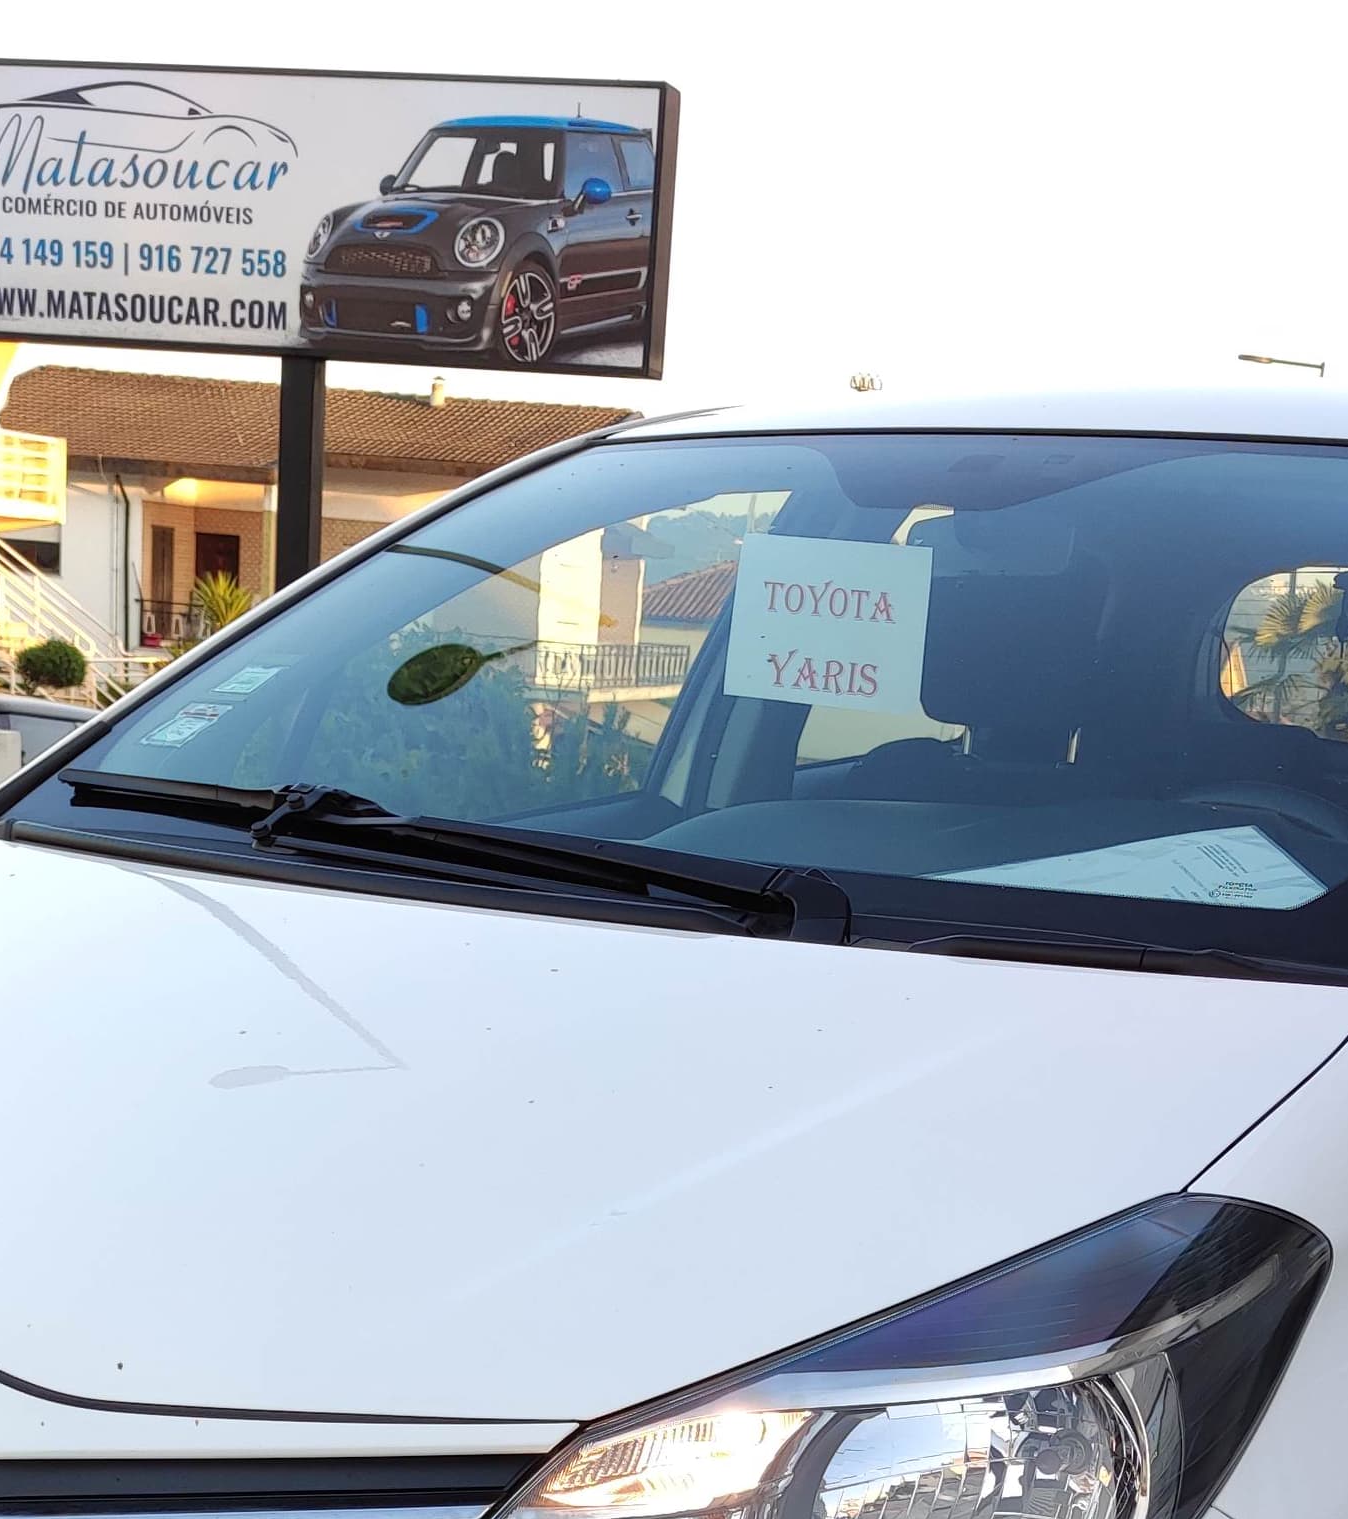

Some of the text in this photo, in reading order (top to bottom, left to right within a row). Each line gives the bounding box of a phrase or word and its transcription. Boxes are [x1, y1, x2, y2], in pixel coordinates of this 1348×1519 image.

[1, 193, 254, 225] COMÉRCIO DE AUTOMÓVEIS
[21, 238, 64, 267] 149
[72, 240, 114, 270] 159
[139, 243, 182, 273] 916
[190, 245, 233, 275] 727
[241, 248, 288, 278] 558
[764, 580, 896, 624] TOYOTA
[768, 648, 879, 697] YARIS
